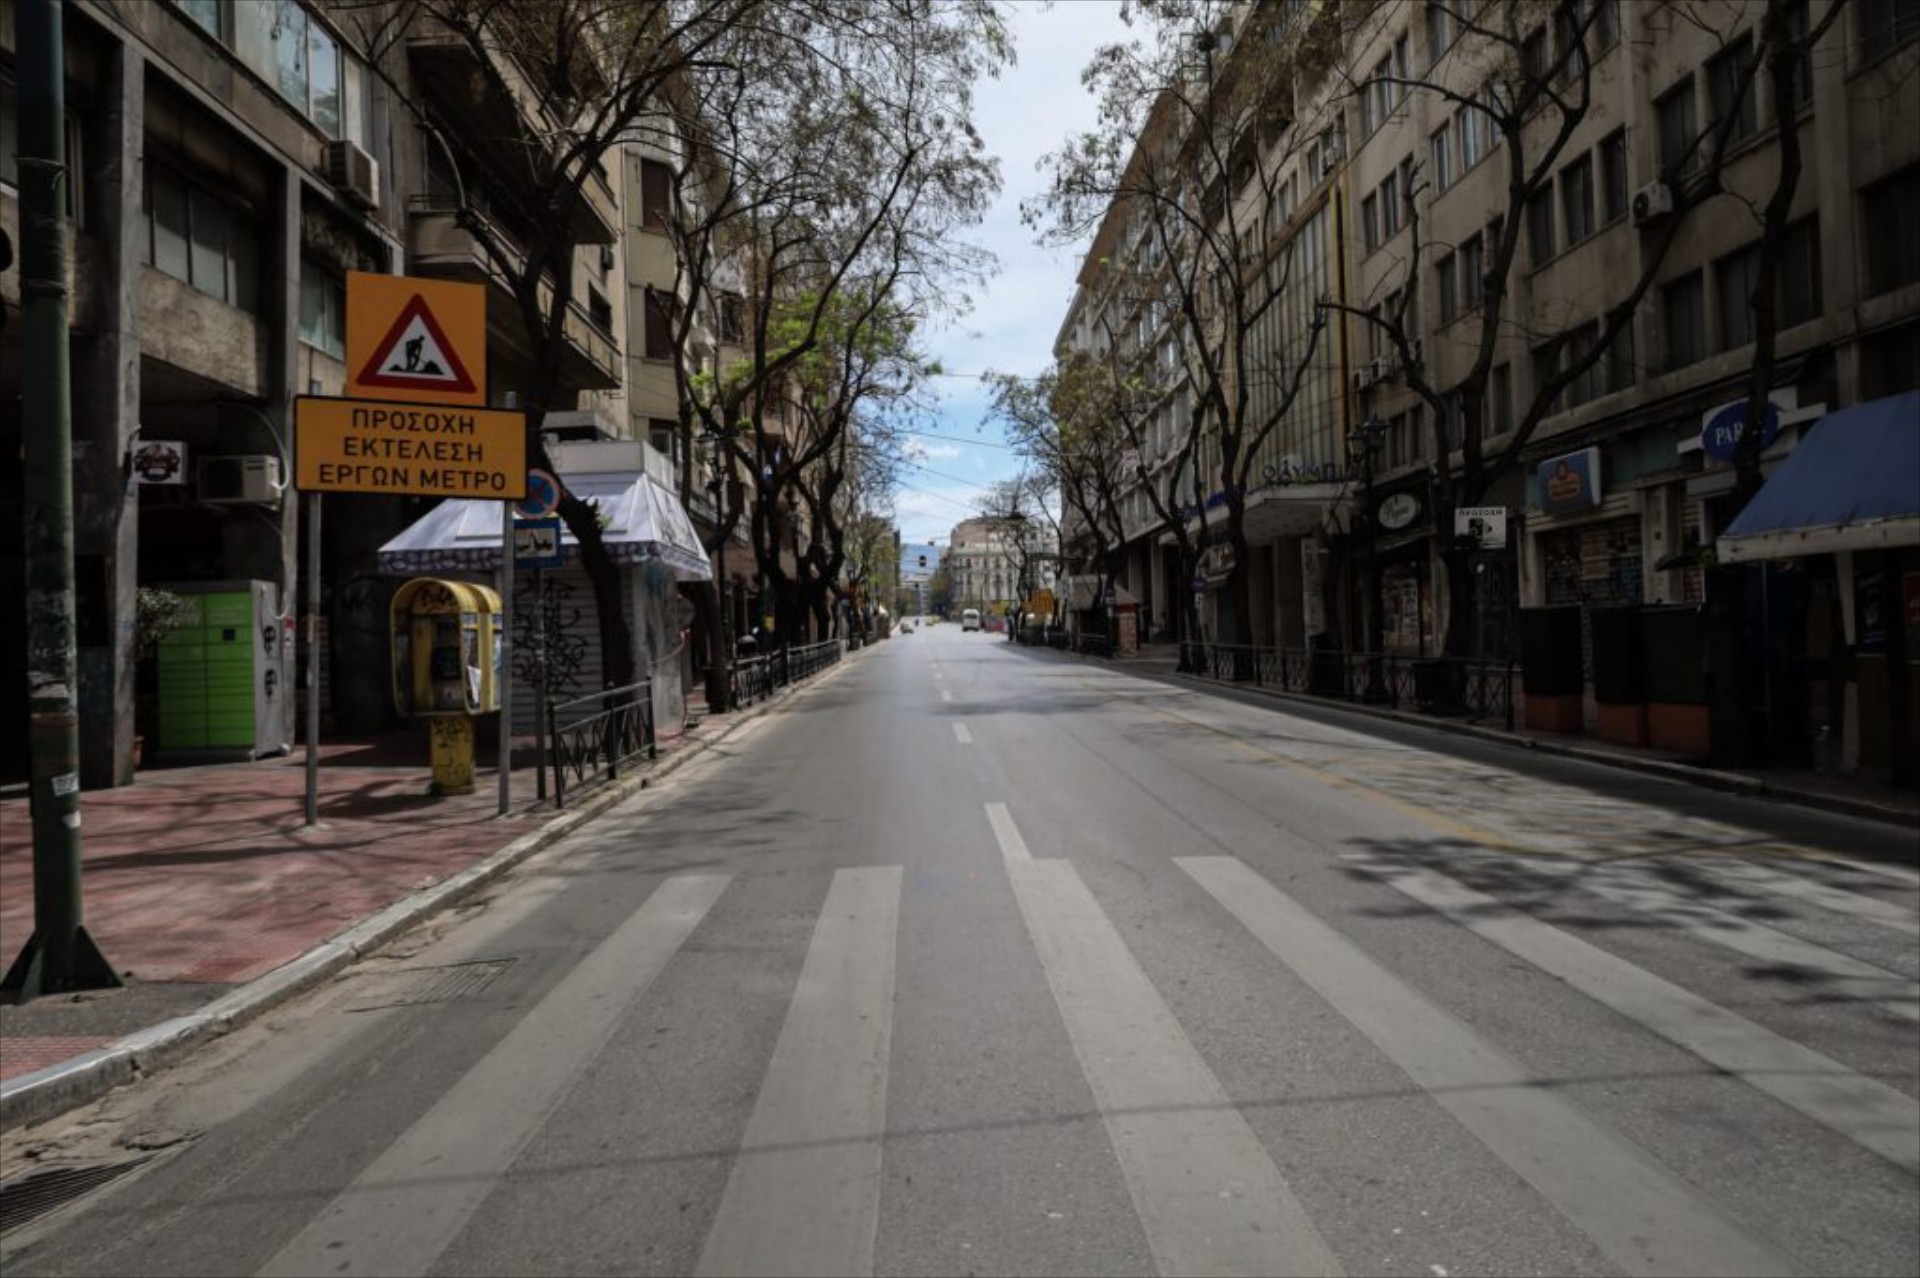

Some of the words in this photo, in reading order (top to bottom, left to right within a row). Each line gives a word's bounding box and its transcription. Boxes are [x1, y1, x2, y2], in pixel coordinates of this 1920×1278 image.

[352, 408, 474, 434] ΠΡΟΣΟΧΗ
[343, 436, 483, 463] ΕΚΤΕΛΕΣΗ
[319, 464, 408, 487] ΕΡΓΩΝ
[420, 469, 505, 491] ΜΕΤΡΟ
